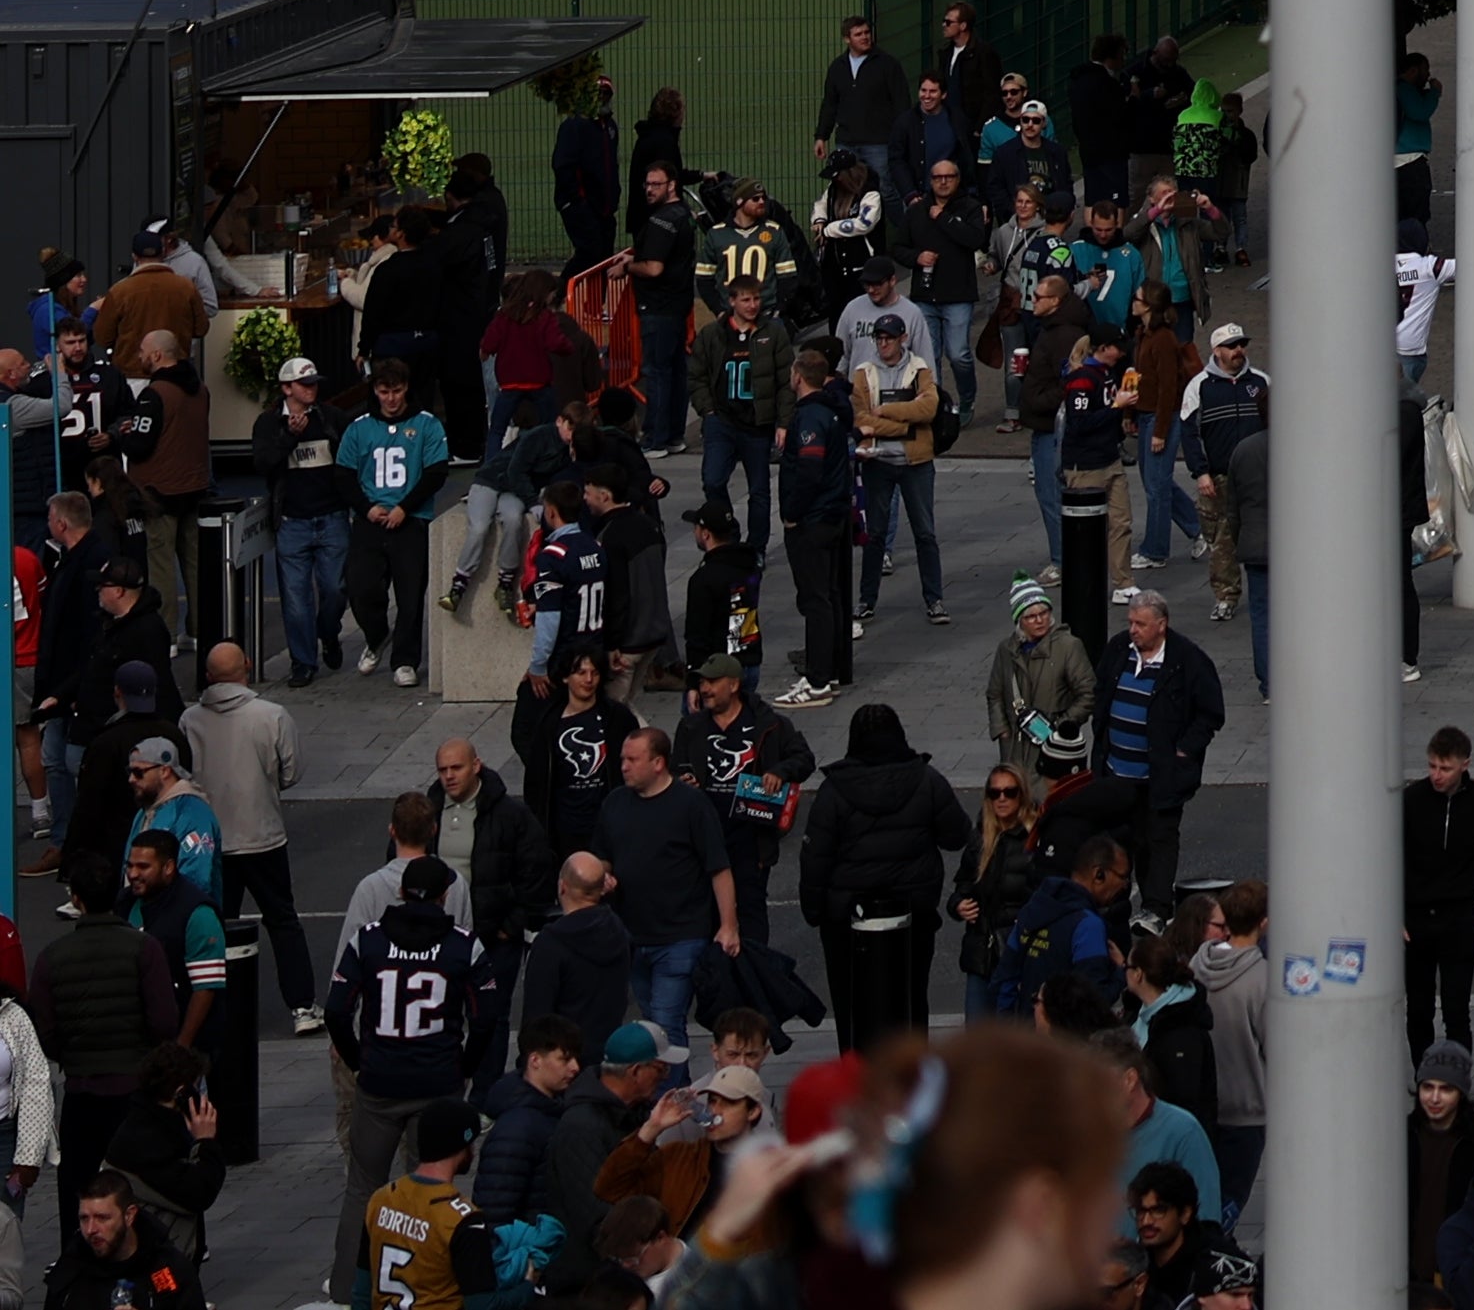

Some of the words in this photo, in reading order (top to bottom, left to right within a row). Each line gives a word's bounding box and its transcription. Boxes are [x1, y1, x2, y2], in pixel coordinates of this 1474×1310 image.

[722, 244, 769, 287] 10
[372, 446, 409, 490] 16
[579, 554, 603, 571] MAYE
[577, 580, 605, 633] 10
[375, 969, 448, 1038] 12
[377, 1206, 431, 1244] BORTLES
[379, 1245, 415, 1310] 5
